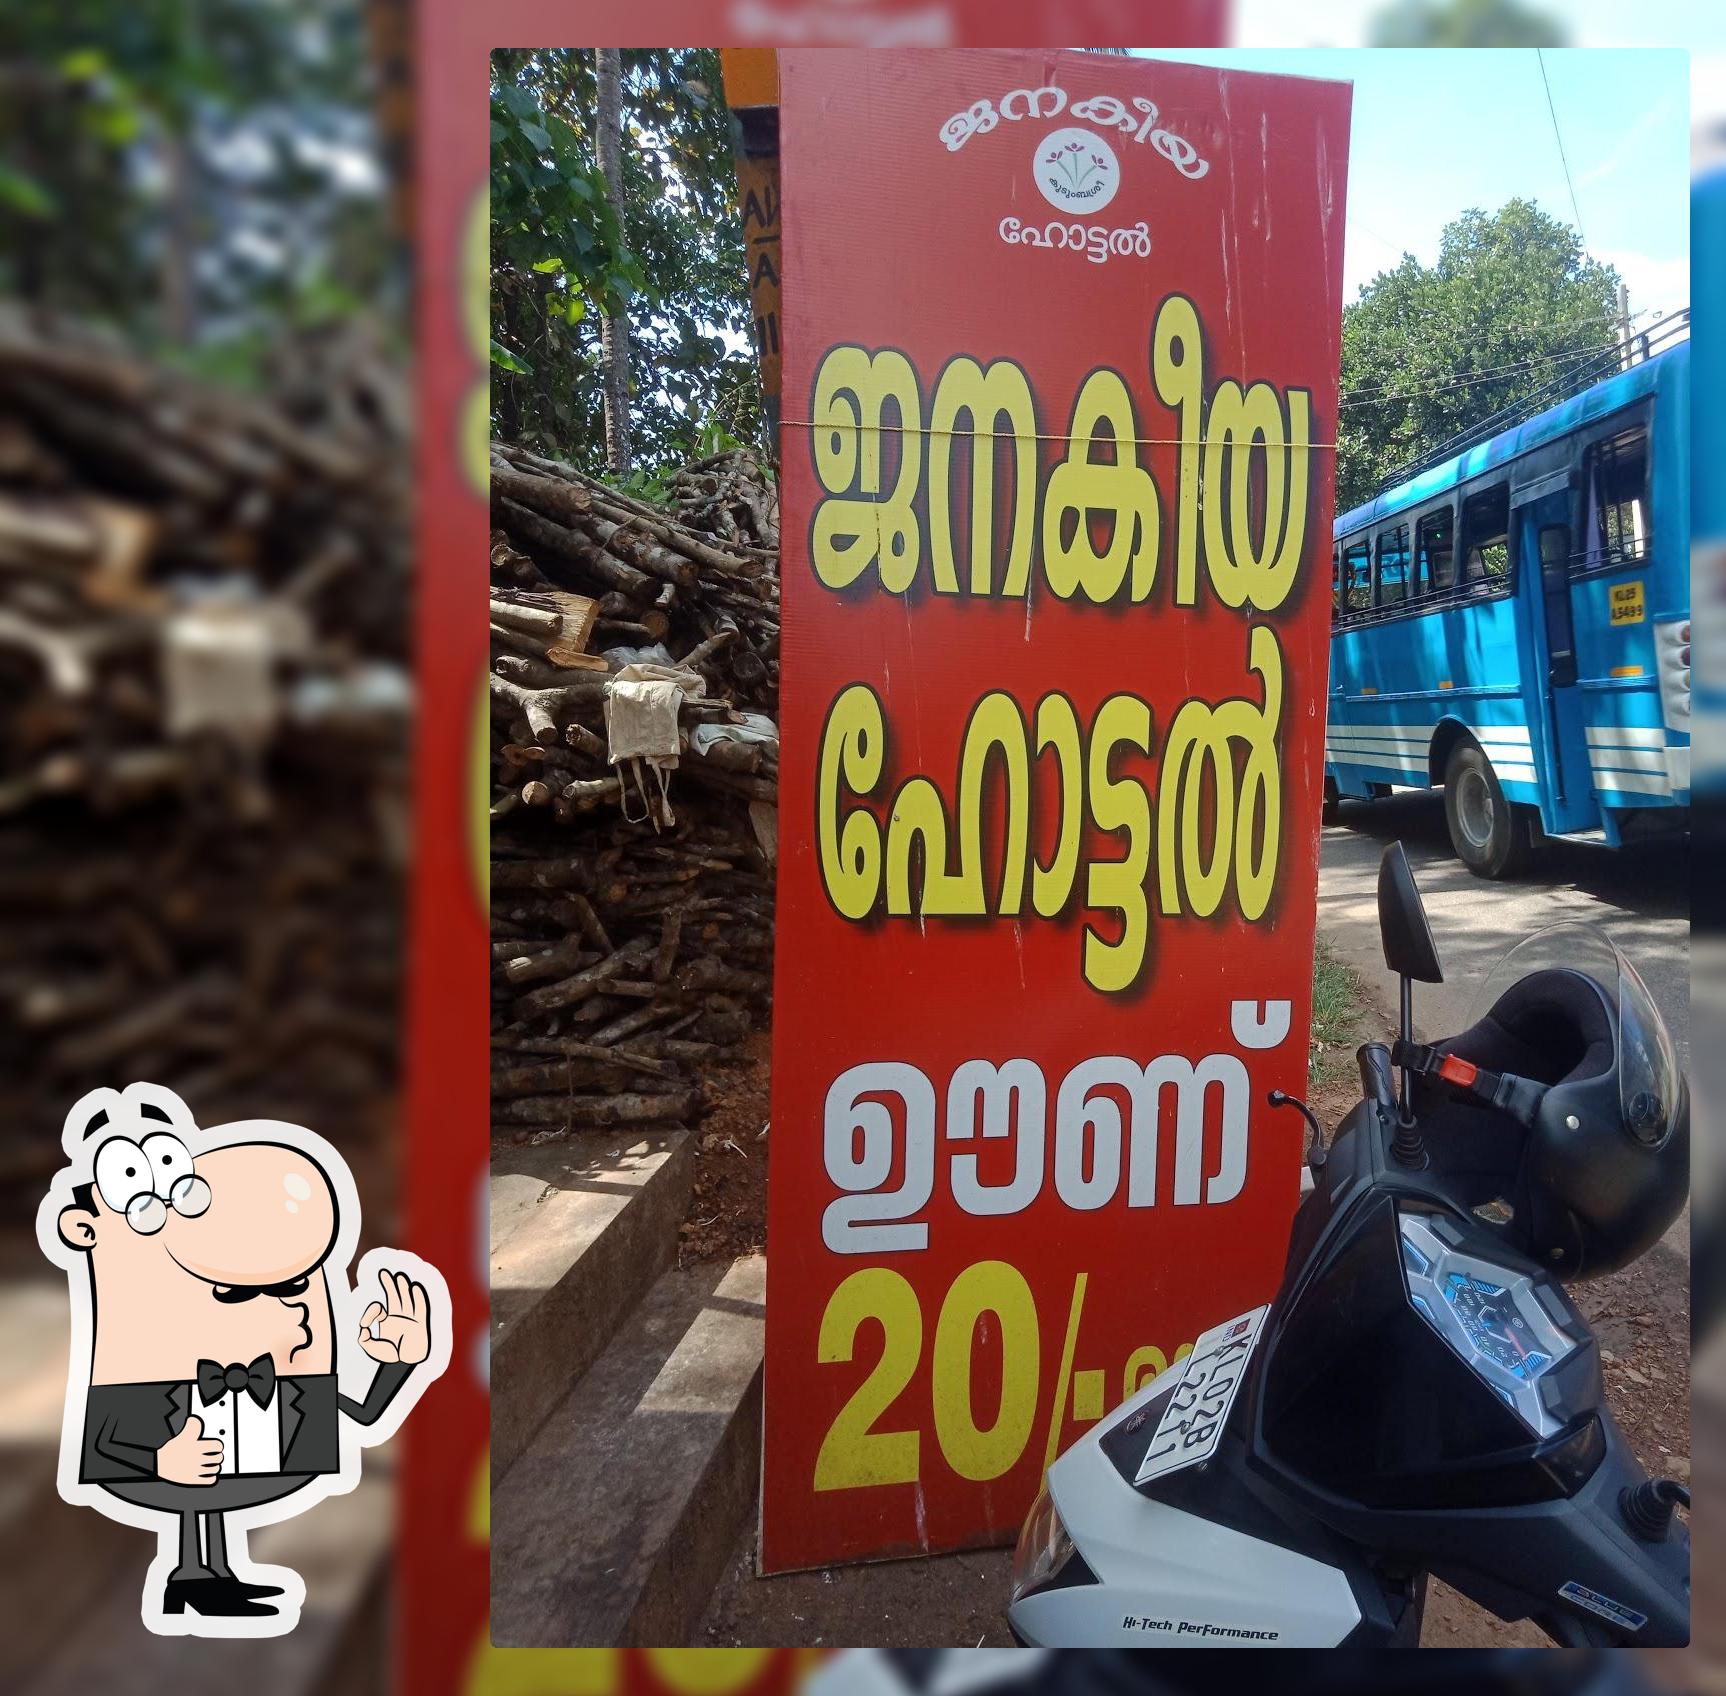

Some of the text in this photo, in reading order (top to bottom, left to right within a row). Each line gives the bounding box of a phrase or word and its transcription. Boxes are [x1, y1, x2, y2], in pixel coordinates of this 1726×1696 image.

[939, 86, 1209, 179] ജനകീയ
[999, 216, 1151, 263] ഹോട്ടൽ
[811, 294, 1311, 613] ജനകീയ
[816, 624, 1284, 993] ഹോട്ടൽ
[821, 1000, 1292, 1256] ഊണ്
[1145, 1349, 1220, 1462] L2211
[1183, 1333, 1253, 1449] KL02B
